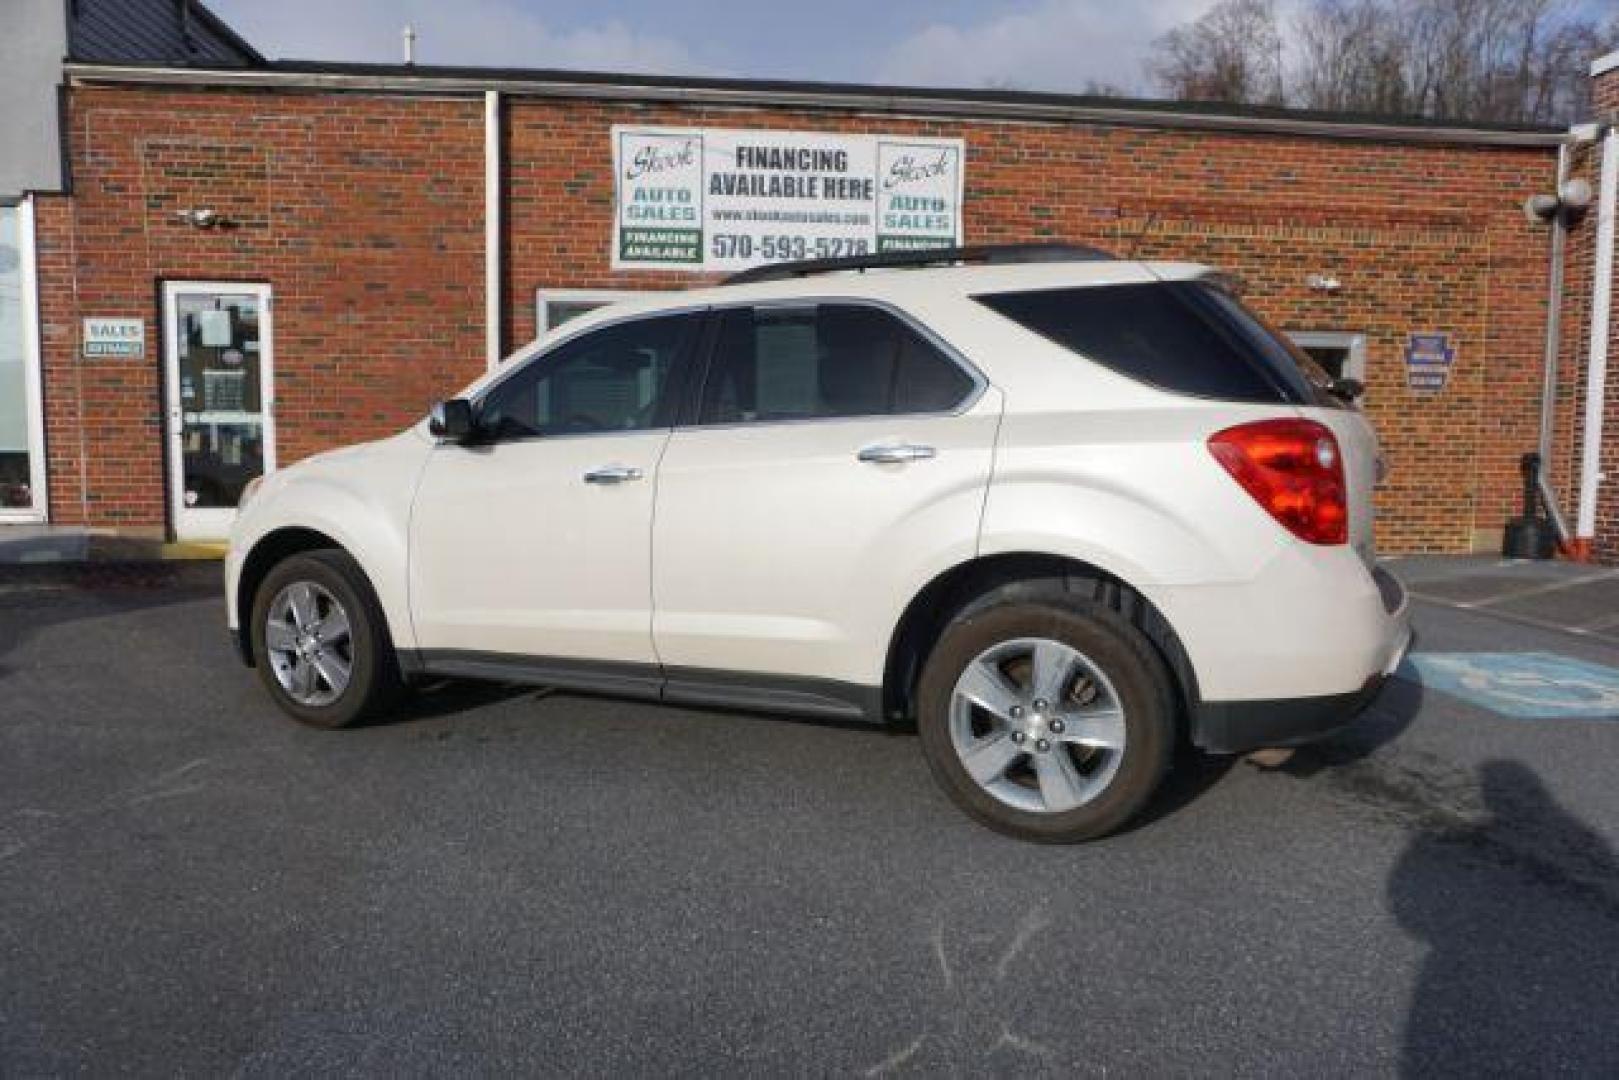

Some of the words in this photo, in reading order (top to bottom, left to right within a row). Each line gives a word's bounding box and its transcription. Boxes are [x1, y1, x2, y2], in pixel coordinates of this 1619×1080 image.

[735, 146, 848, 172] FINANCING
[708, 171, 818, 198] AVAILABLE
[822, 176, 874, 200] HERE
[634, 187, 692, 203] AUTO
[889, 194, 945, 213] AUTO
[626, 204, 697, 221] SALES
[884, 213, 950, 231] SALES
[626, 231, 699, 244] FINANCING
[625, 245, 698, 259] AVAILABLE
[90, 324, 140, 337] SALES
